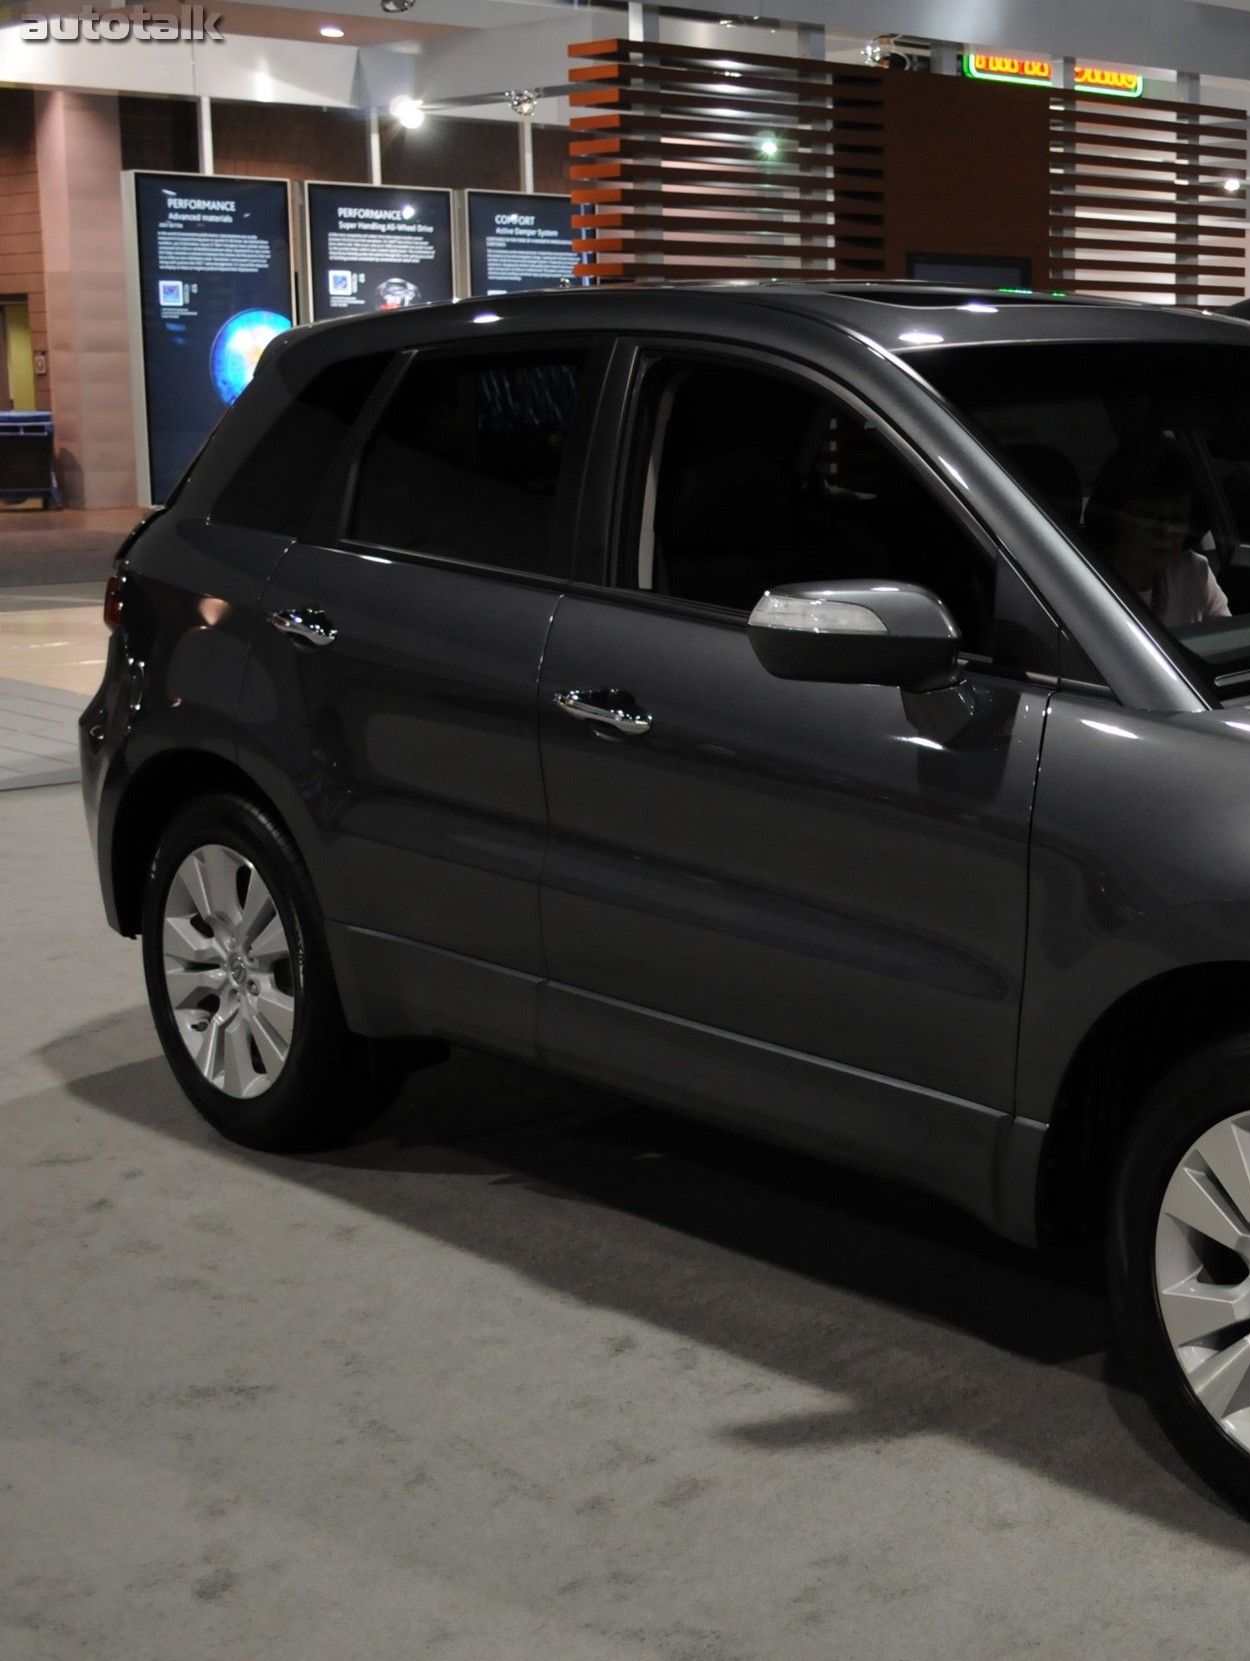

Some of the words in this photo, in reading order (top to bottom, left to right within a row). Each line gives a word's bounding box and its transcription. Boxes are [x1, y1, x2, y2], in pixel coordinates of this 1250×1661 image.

[168, 198, 236, 212] PERFORMANCE
[168, 213, 200, 222] Advanced
[202, 214, 233, 223] materials
[338, 208, 402, 220] PERFORMANCE
[495, 215, 536, 225] COMFORT
[338, 222, 358, 230] Super
[359, 222, 386, 232] Handling
[417, 225, 434, 233] Drive
[495, 227, 514, 235] Active
[538, 229, 559, 238] System
